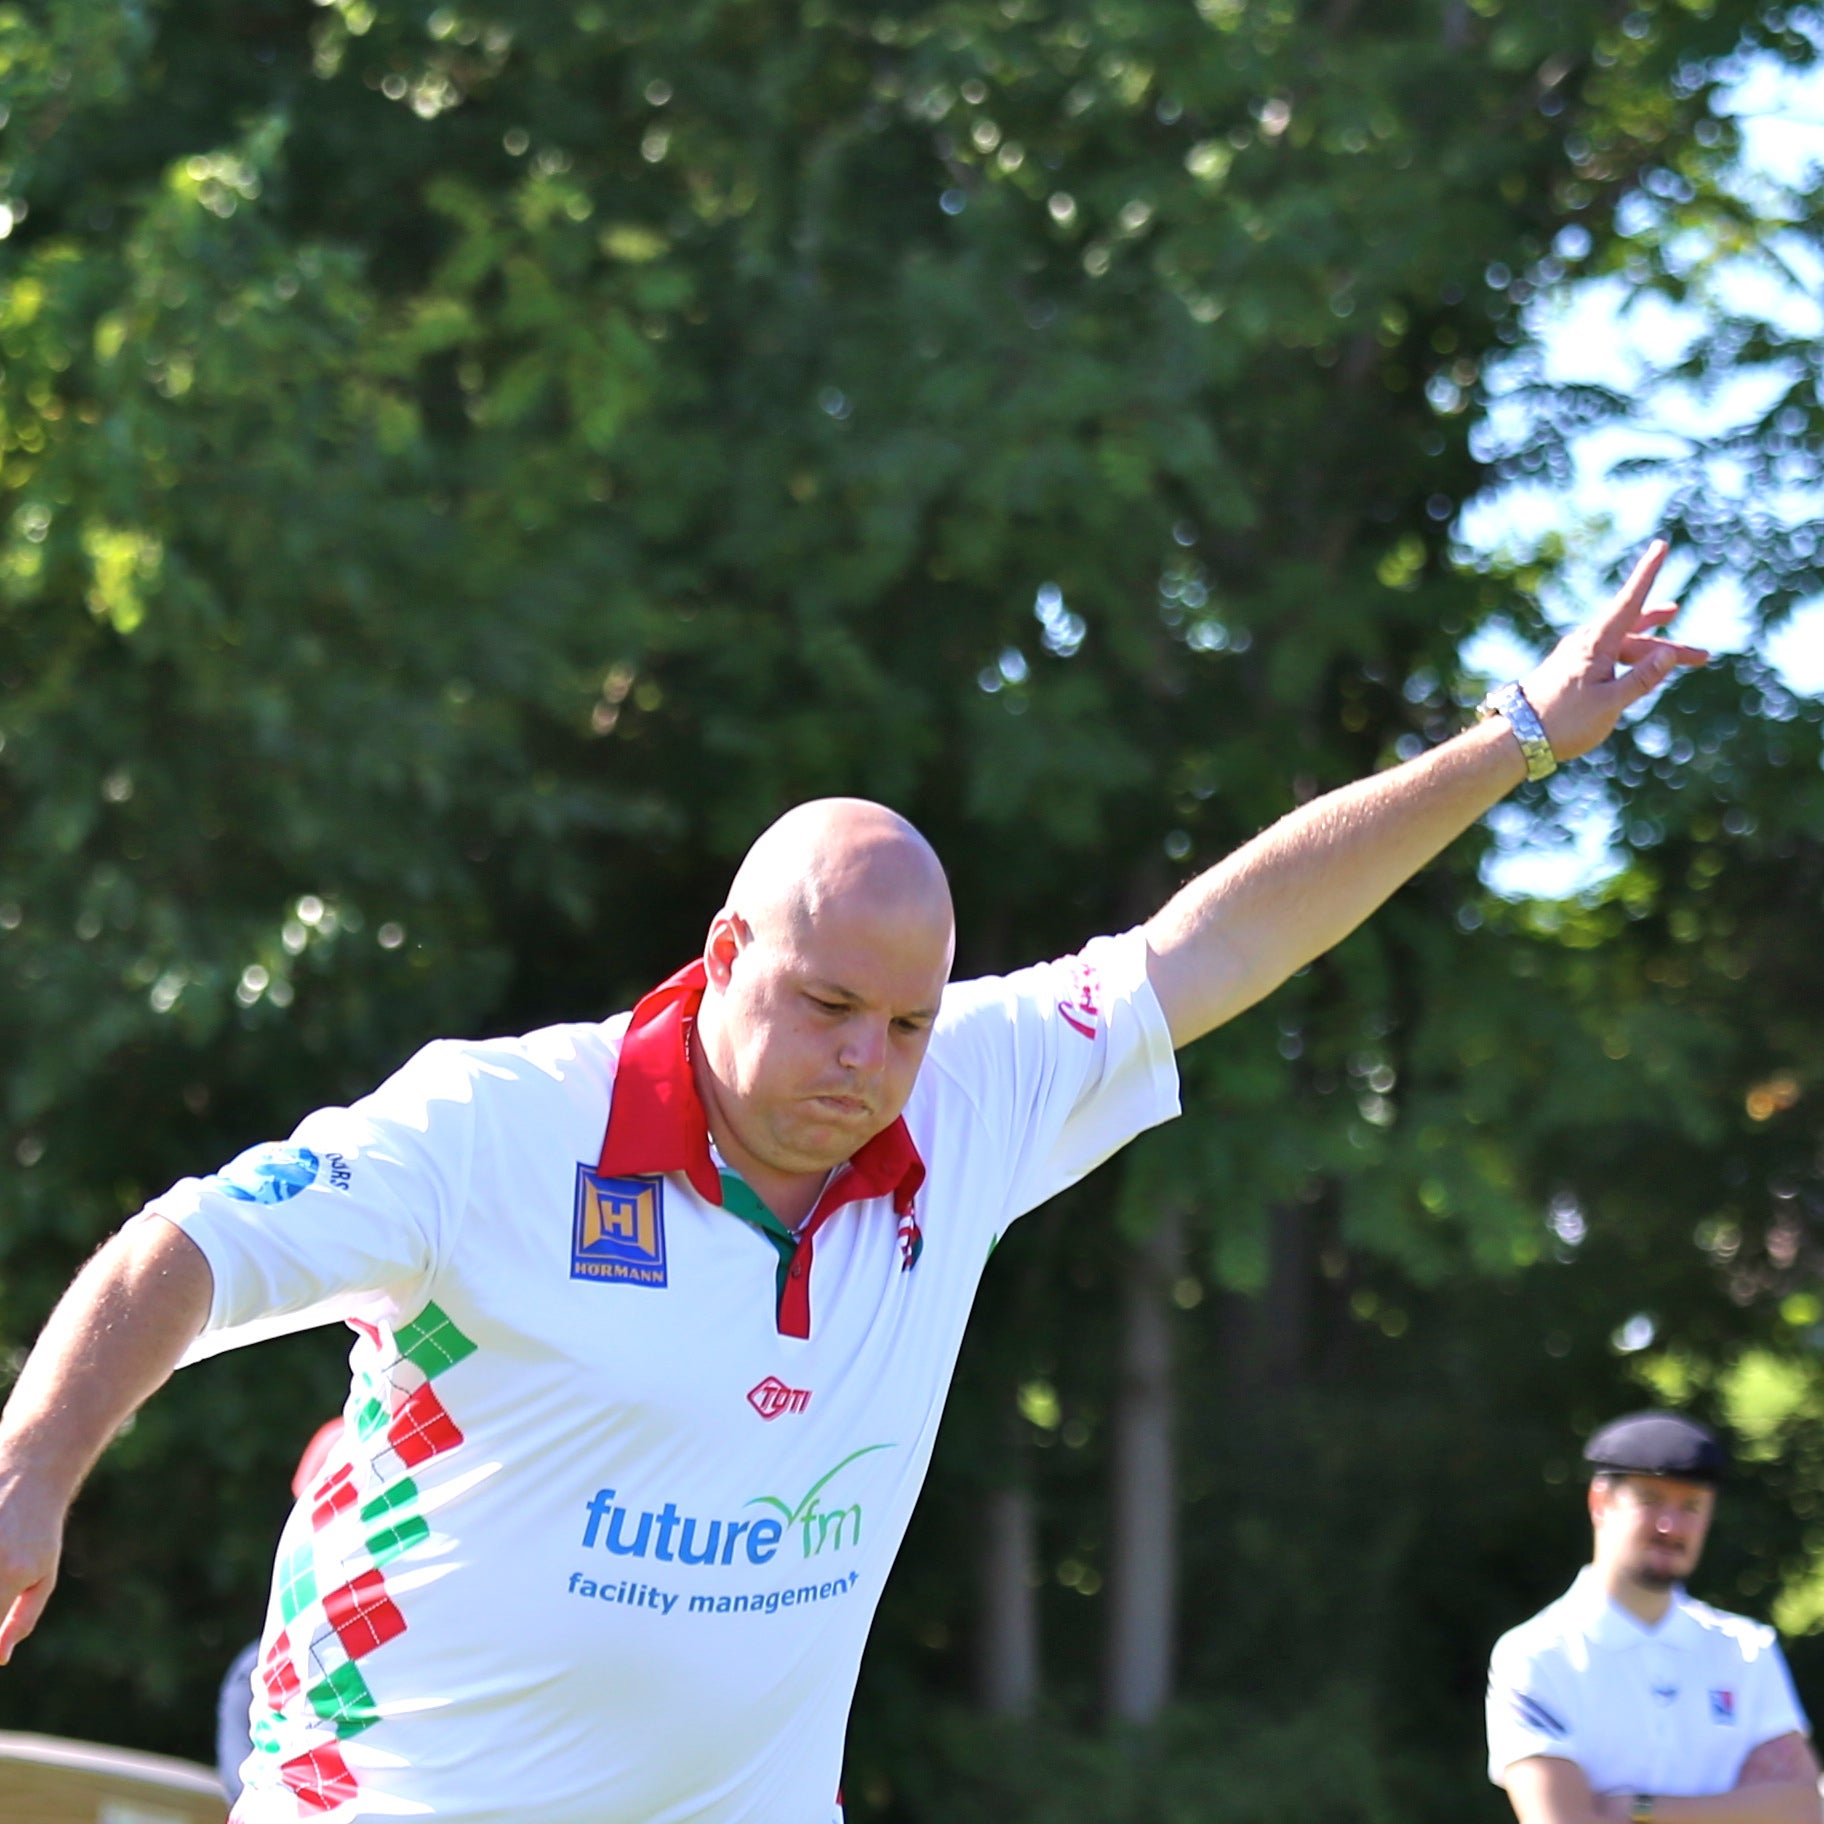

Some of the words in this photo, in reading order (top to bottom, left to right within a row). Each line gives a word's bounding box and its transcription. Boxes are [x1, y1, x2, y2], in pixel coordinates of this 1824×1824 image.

[600, 1200, 633, 1238] H
[581, 1488, 783, 1566] future
[801, 1498, 862, 1559] fm
[567, 1571, 679, 1616] facility
[687, 1570, 860, 1614] management
